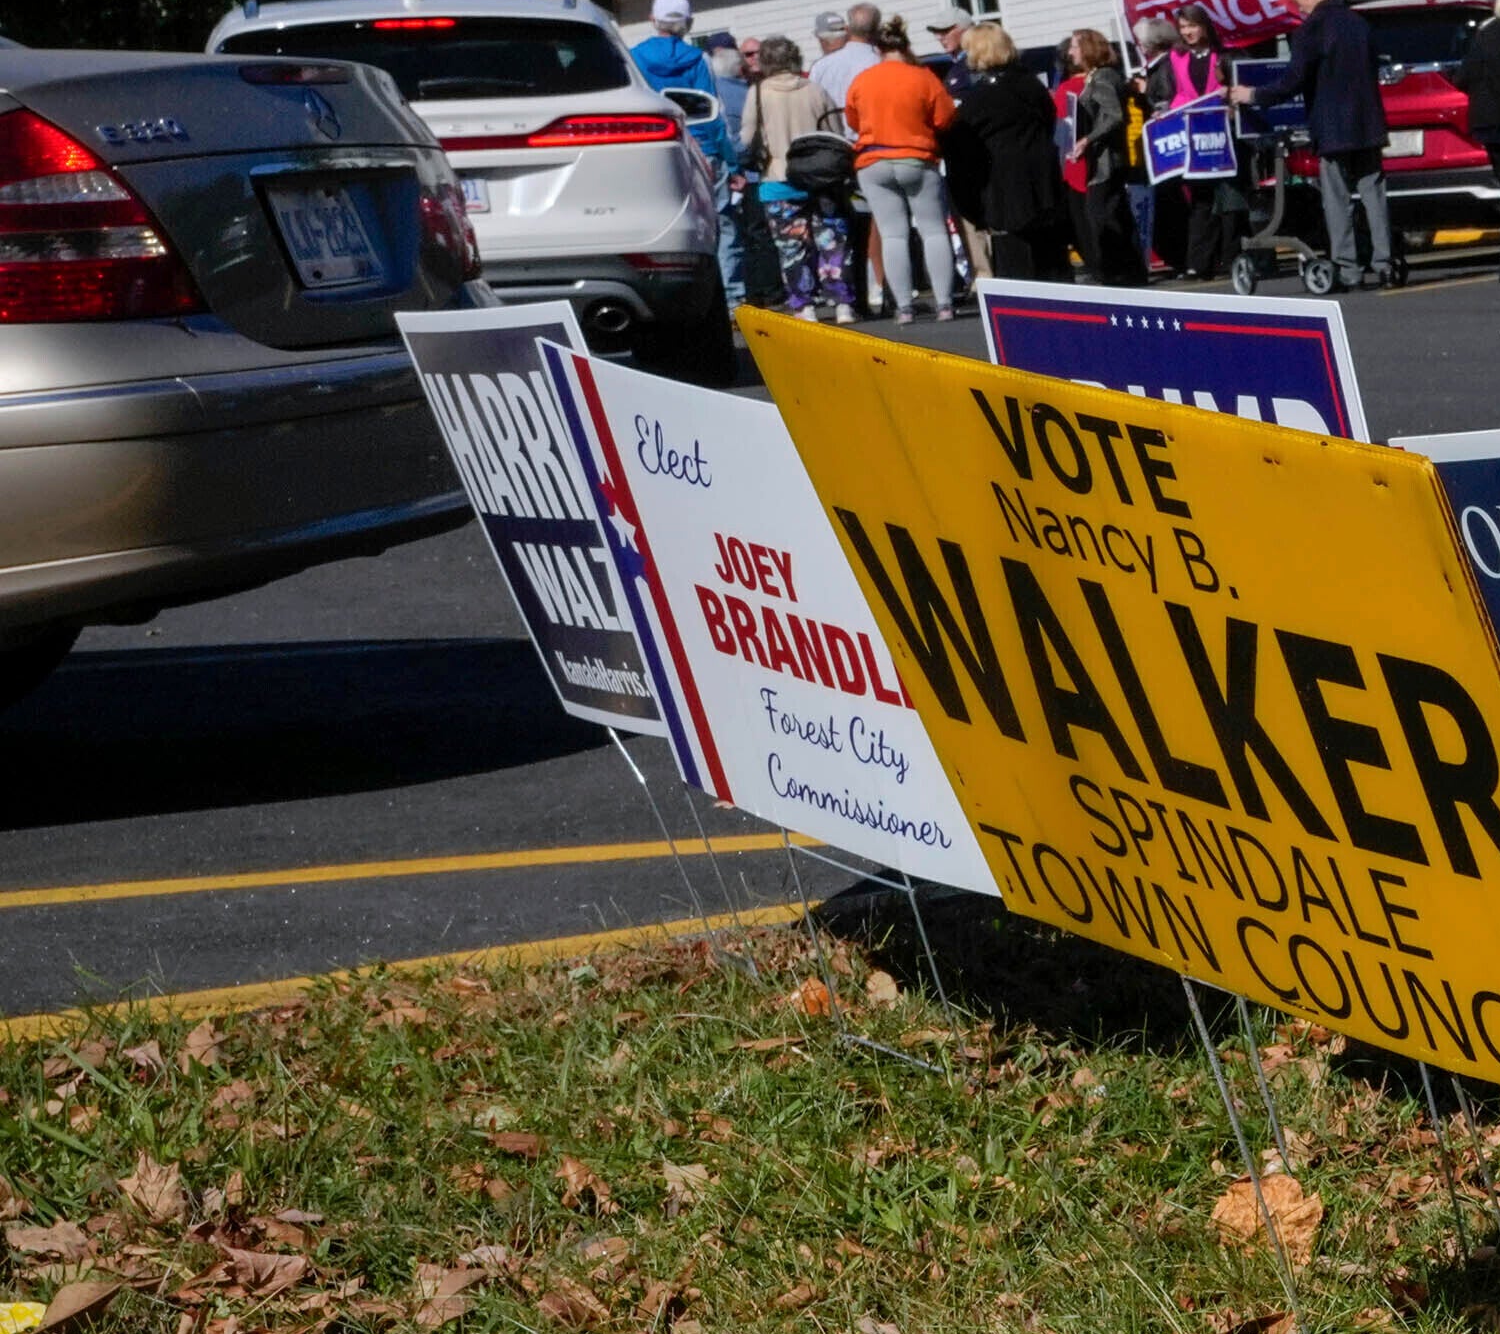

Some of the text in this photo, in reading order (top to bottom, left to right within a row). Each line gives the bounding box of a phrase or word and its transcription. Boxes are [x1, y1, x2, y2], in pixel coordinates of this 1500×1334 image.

[634, 414, 712, 488] Elect
[969, 387, 1192, 519] VOTE
[713, 532, 797, 603] JOEY
[990, 481, 1240, 600] Nancy B.
[695, 584, 916, 710] BRANDL
[760, 687, 909, 784] Forest City
[768, 753, 952, 849] Commissioner
[978, 822, 1224, 973] TOWN
[1069, 774, 1432, 960] SPINDALE
